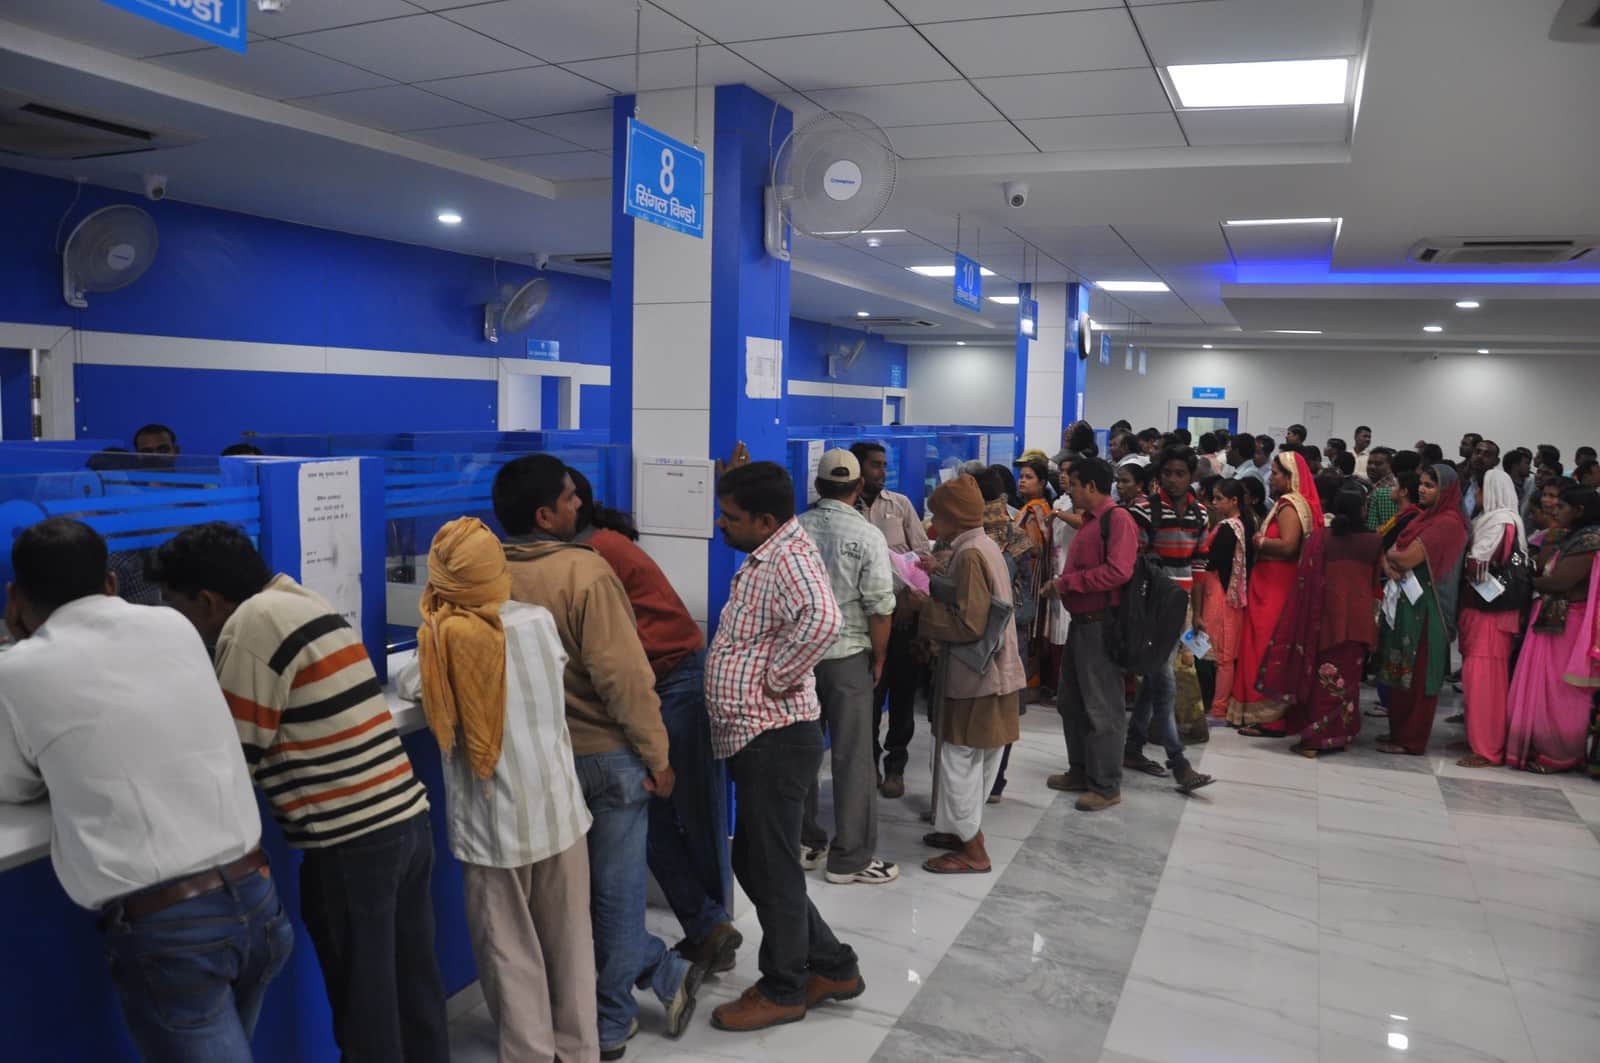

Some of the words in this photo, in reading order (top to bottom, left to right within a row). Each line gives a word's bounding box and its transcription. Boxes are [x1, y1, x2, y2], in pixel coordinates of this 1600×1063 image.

[660, 148, 674, 195] 8
[635, 184, 669, 213] सिंगल
[963, 263, 974, 290] 10
